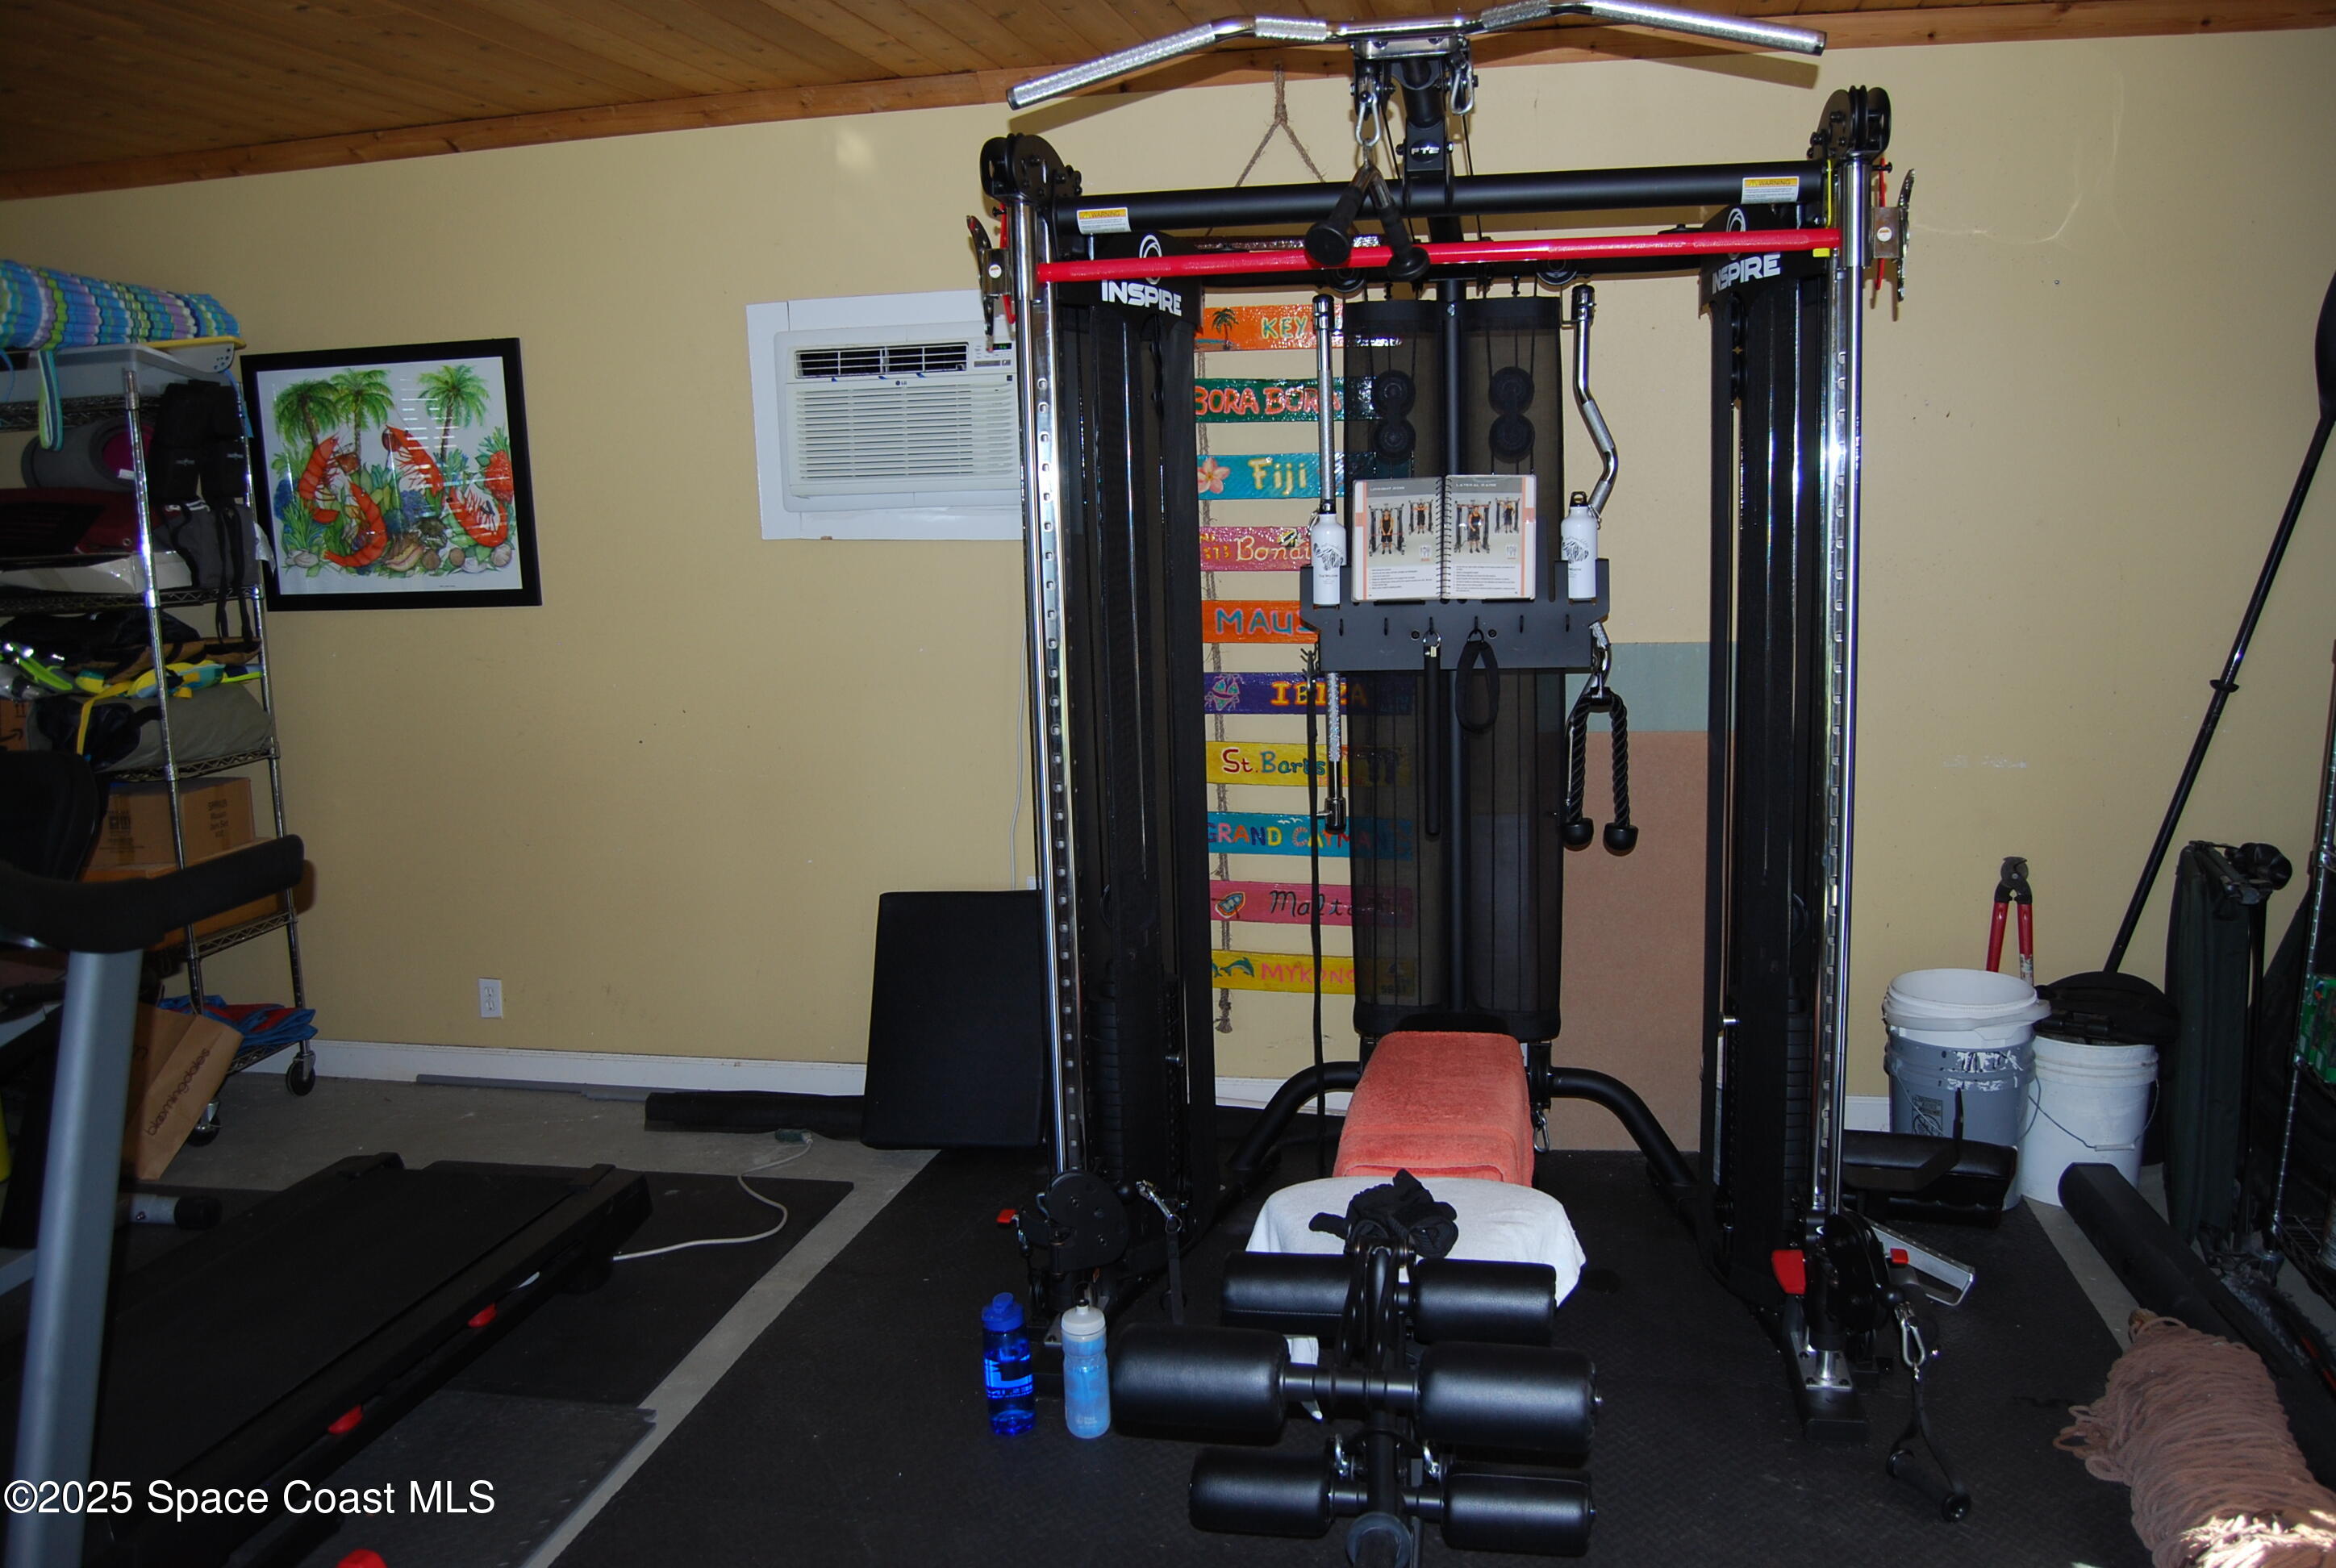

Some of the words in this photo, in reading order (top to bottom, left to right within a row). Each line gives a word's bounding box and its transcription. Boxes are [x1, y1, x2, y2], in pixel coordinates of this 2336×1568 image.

[1712, 252, 1781, 295] INSPIRE
[1101, 279, 1182, 317] INSPIRE
[1261, 315, 1308, 340] KEY
[1195, 385, 1260, 415] BORA
[1247, 457, 1308, 496] Fiji
[1221, 747, 1259, 774] St.
[1208, 822, 1283, 847] GRAND
